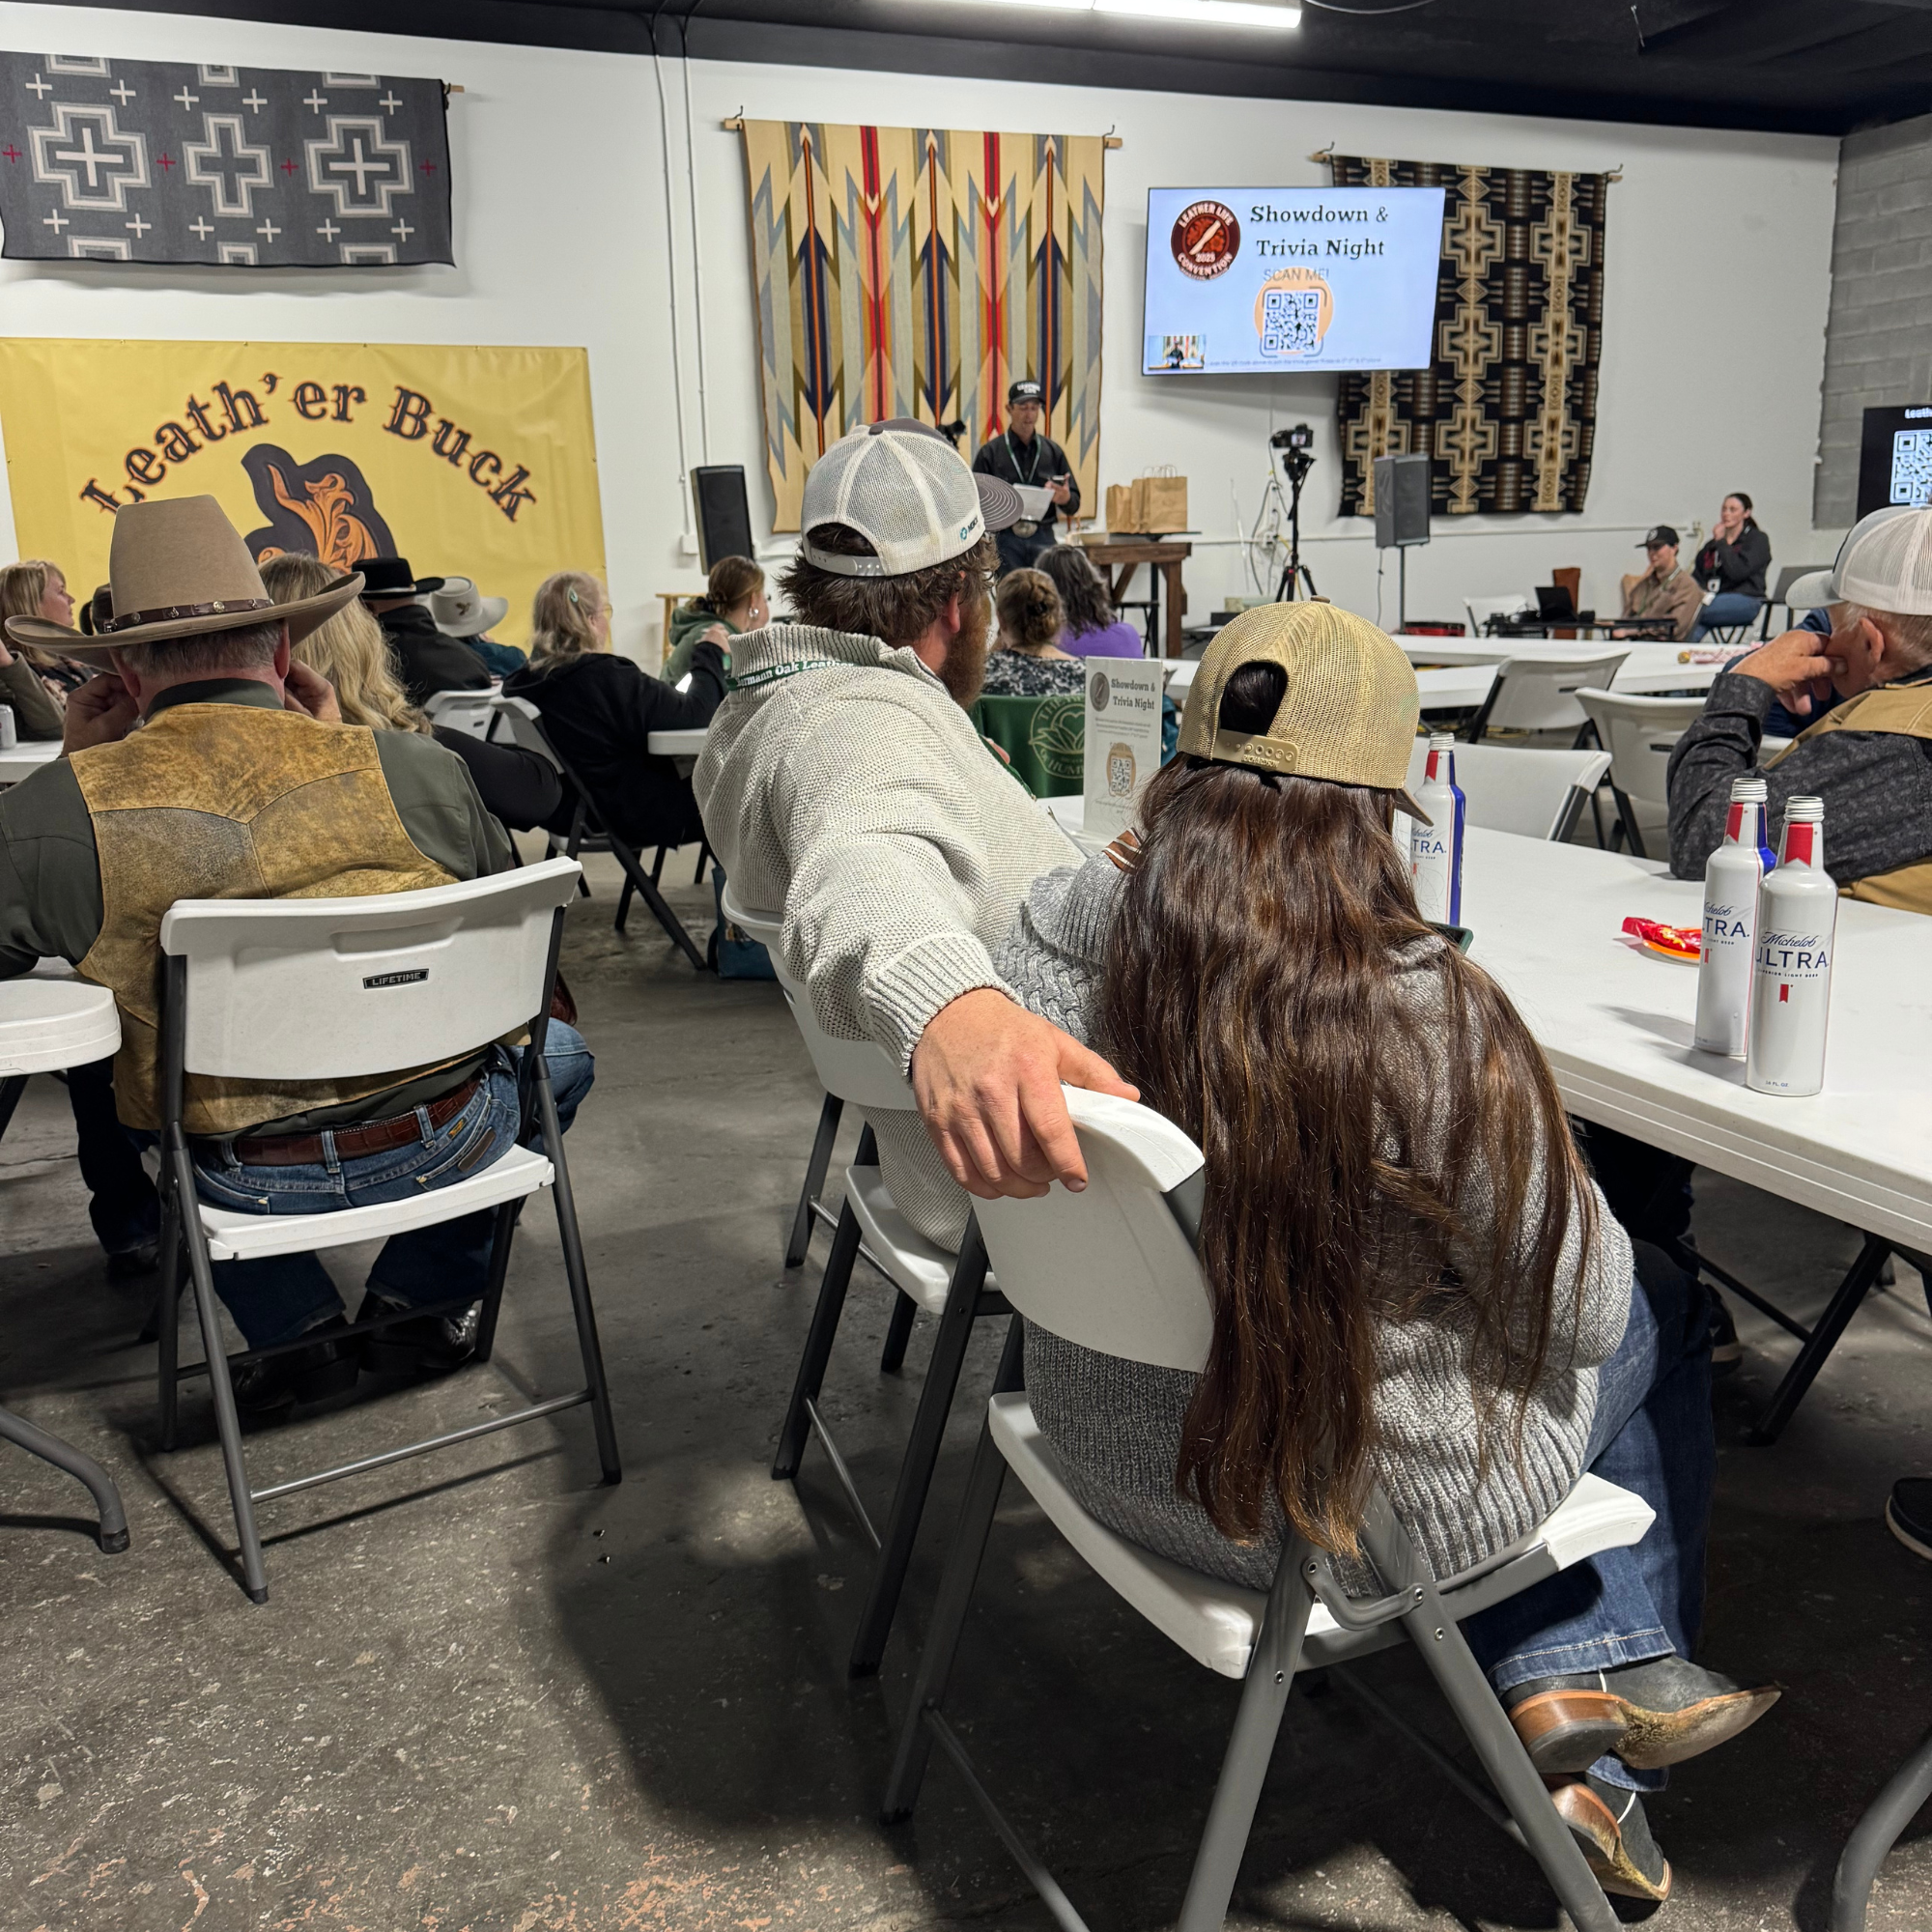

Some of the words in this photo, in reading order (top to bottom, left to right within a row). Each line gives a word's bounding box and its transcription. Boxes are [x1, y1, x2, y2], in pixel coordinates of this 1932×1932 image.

[1178, 203, 1217, 228] LEATHER
[1250, 205, 1369, 222] Showdown
[1376, 206, 1388, 222] &
[1256, 239, 1319, 256] Trivia
[1325, 238, 1384, 260] Night
[1178, 251, 1234, 276] CONVENTION
[1263, 268, 1301, 281] SCAN
[382, 384, 537, 523] Buck
[775, 662, 800, 675] Oak
[1111, 678, 1150, 692] Showdown
[1113, 696, 1133, 707] Trivia
[1134, 697, 1155, 711] Night
[1412, 838, 1447, 854] TRA
[1703, 916, 1747, 937] TRA
[1761, 931, 1819, 947] Michelob
[372, 972, 421, 986] LIFETIME
